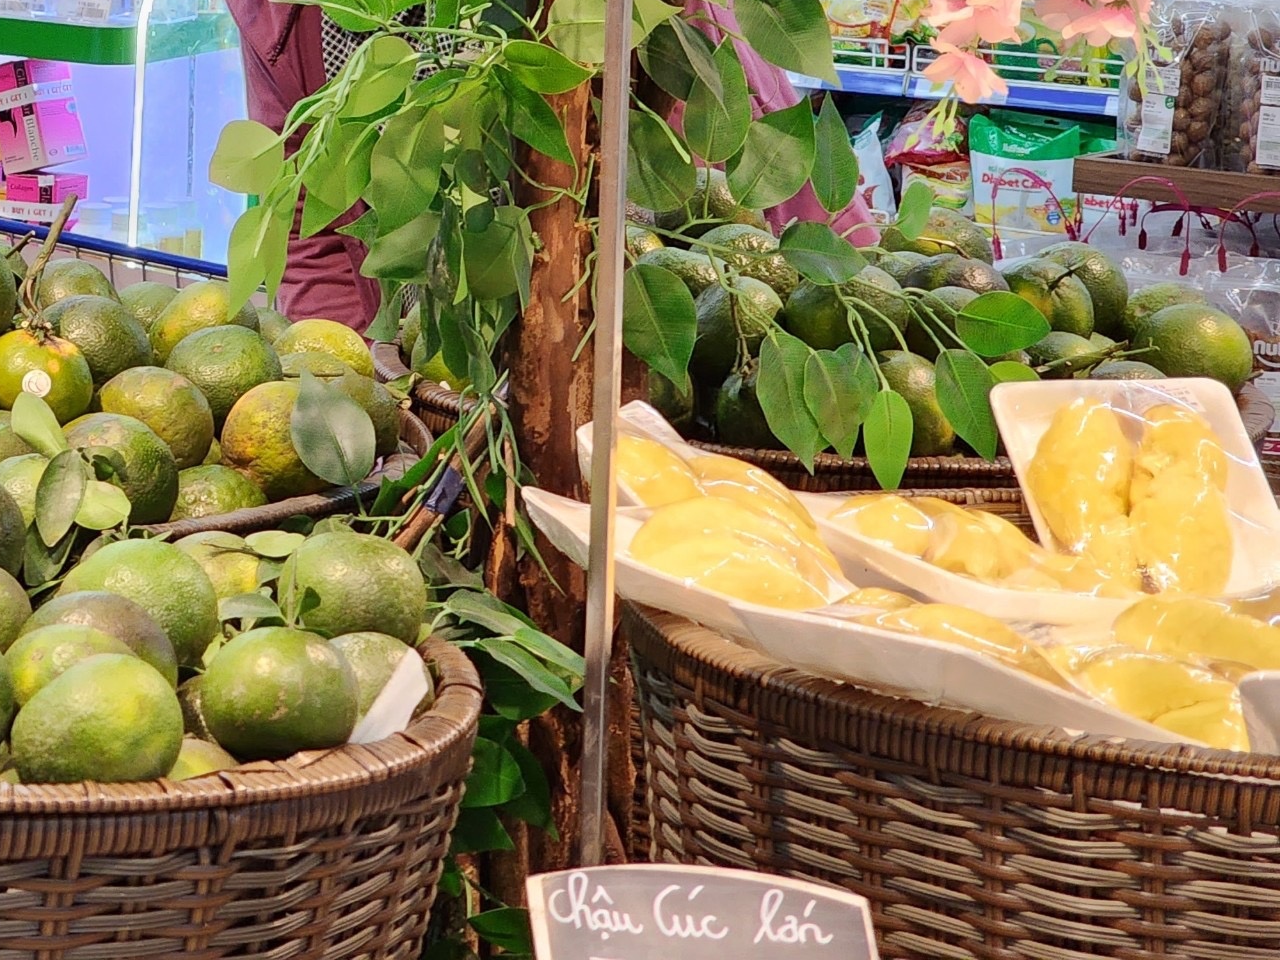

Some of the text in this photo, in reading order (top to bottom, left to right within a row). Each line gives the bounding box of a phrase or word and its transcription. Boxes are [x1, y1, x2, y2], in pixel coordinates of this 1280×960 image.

[25, 117, 41, 162] Blanche
[11, 205, 25, 215] BUY
[33, 207, 47, 217] GET
